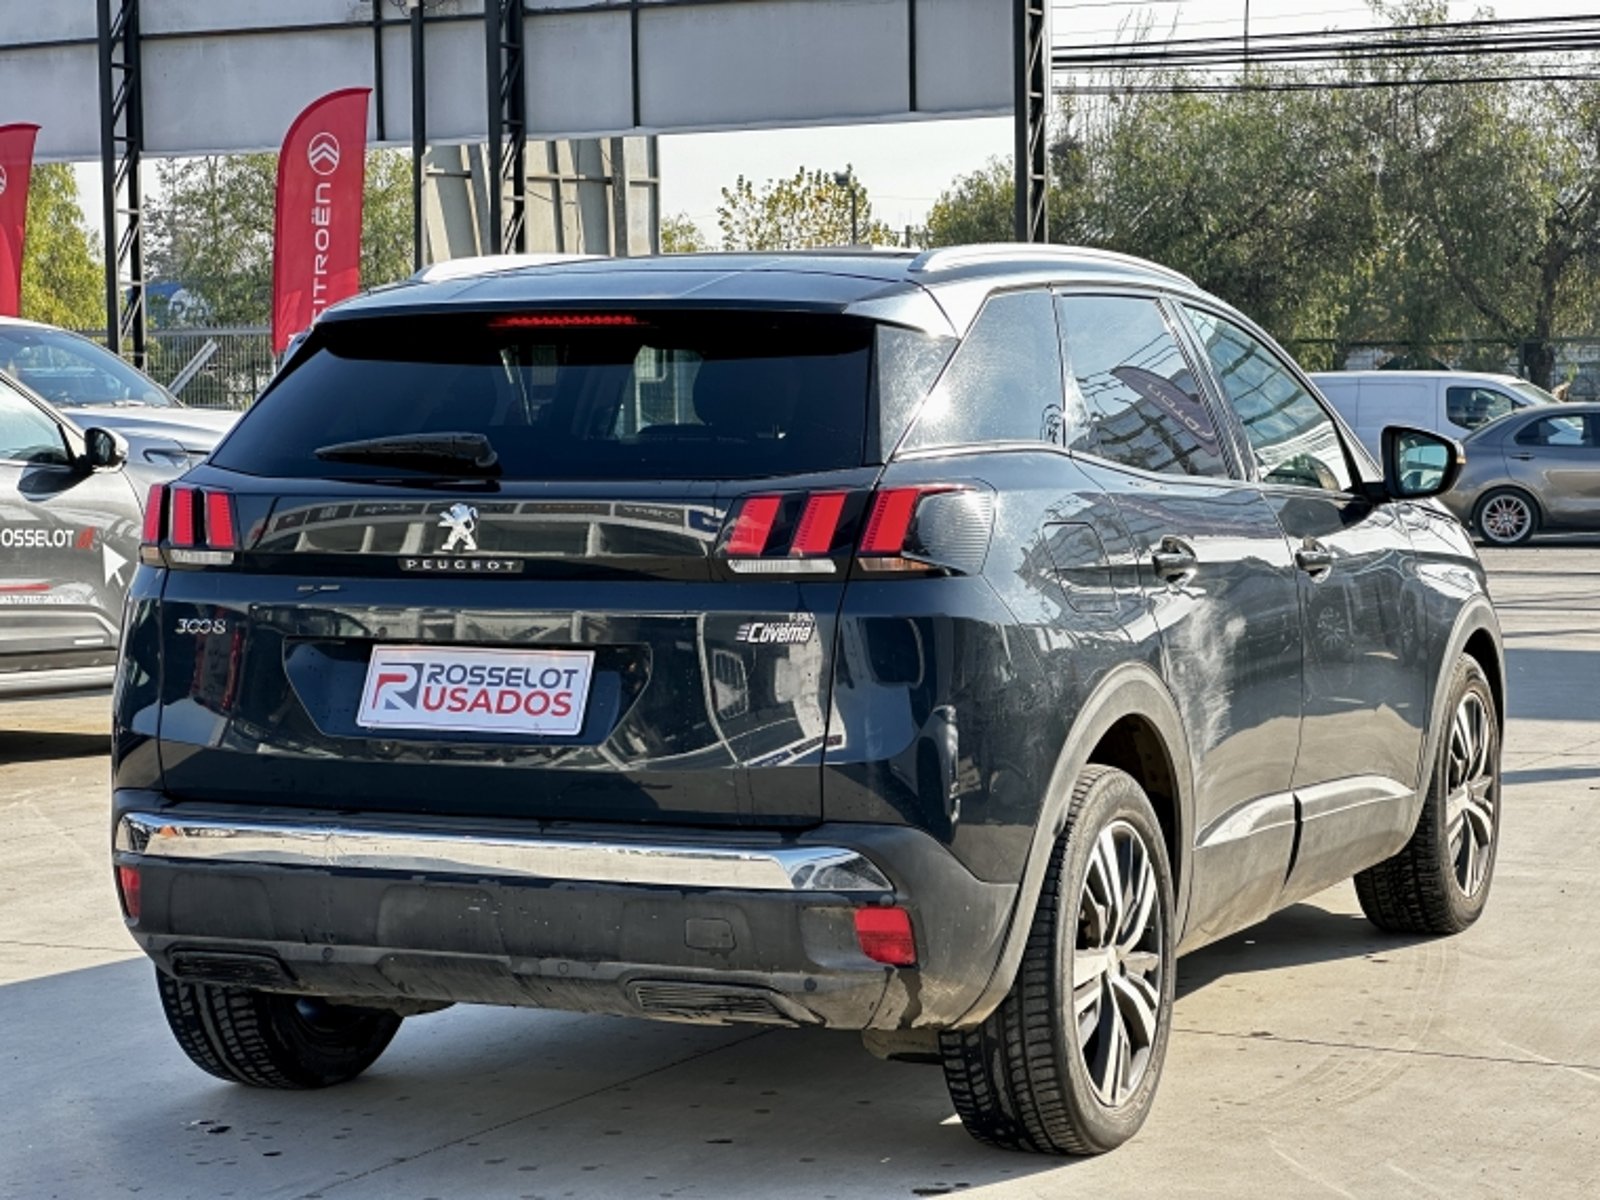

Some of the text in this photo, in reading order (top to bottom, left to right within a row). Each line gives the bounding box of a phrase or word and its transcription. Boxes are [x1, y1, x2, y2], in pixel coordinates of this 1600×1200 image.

[0, 527, 75, 547] OSSELOT
[406, 559, 515, 571] PEUGEOT
[175, 618, 226, 635] 3008
[427, 663, 579, 689] ROSSELOT
[422, 686, 573, 717] USADOS
